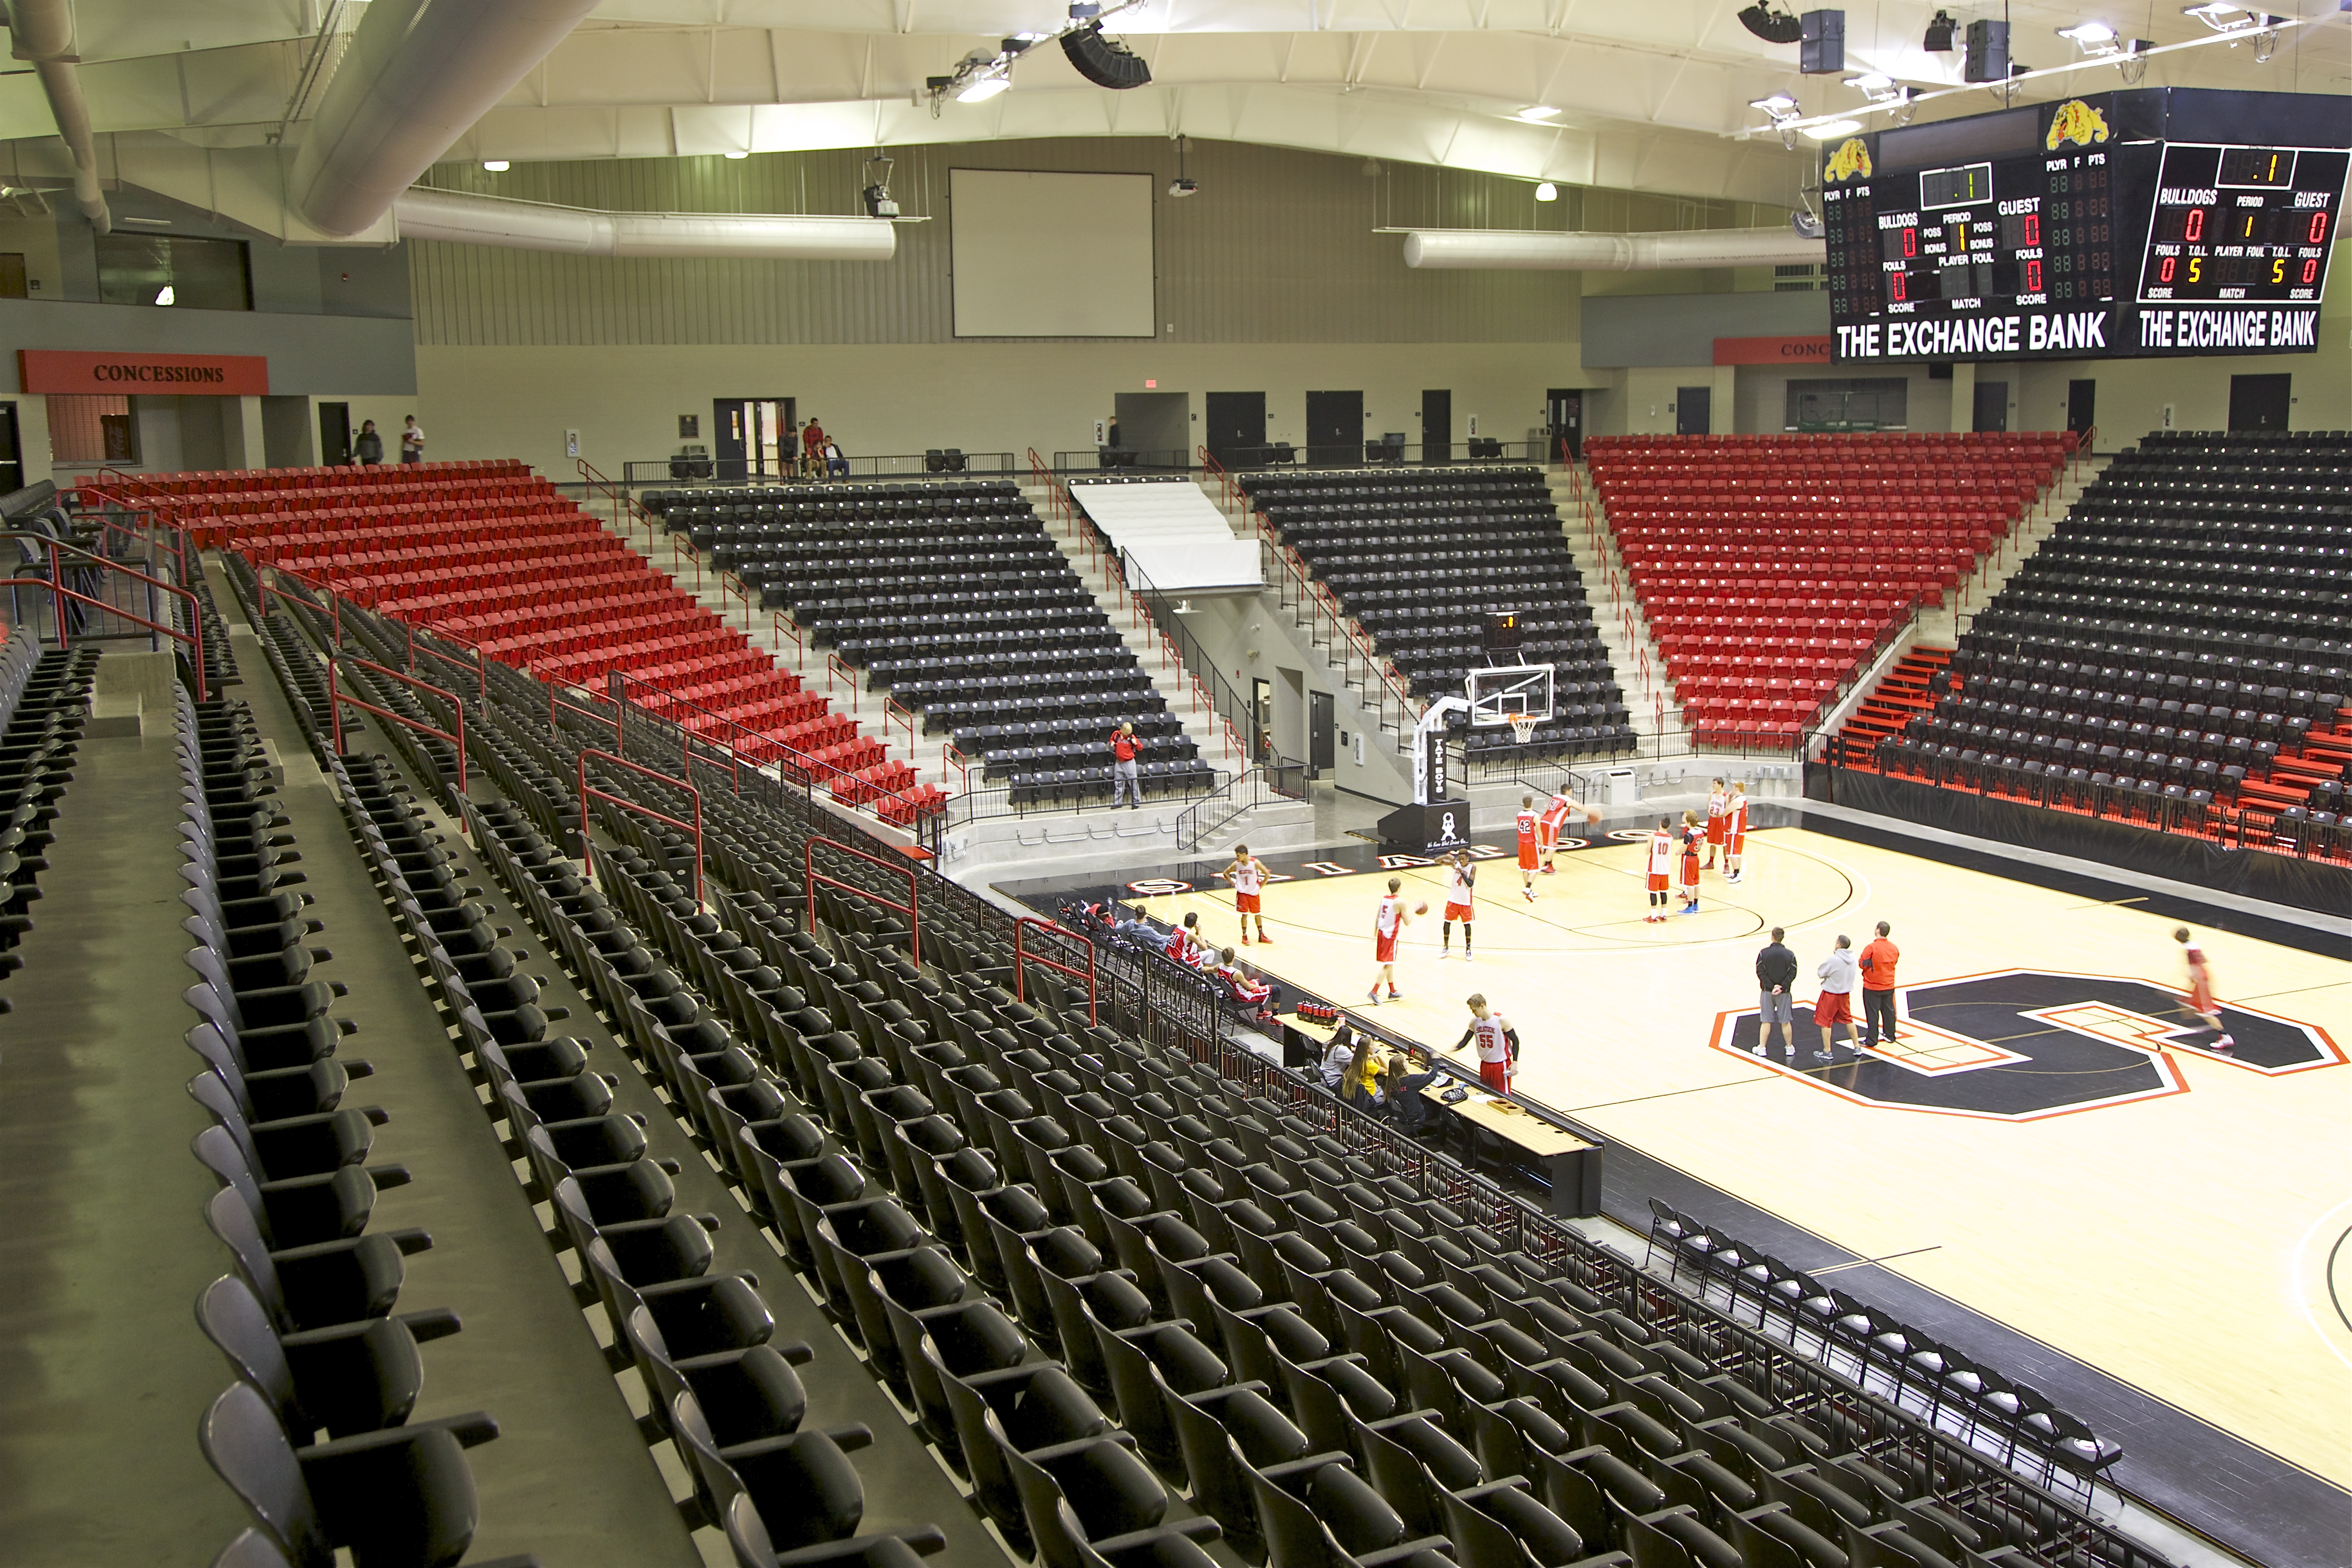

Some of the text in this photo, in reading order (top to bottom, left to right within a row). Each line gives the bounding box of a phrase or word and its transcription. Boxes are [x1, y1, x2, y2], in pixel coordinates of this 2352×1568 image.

[2046, 153, 2105, 171] PLYR F PTS
[1824, 186, 1870, 201] PLYR F PTS
[2160, 188, 2218, 205] BULLDOGS
[2295, 193, 2330, 207] GUEST
[1998, 197, 2040, 216] GUEST
[2237, 196, 2264, 207] PERIOD
[1879, 212, 1918, 230] BULLDOGS
[1943, 212, 1971, 224] PERIOD
[2186, 209, 2203, 241] 0
[1924, 227, 1942, 238] POSS
[1973, 221, 1993, 233] POSS
[2025, 215, 2039, 245] 0
[2245, 216, 2253, 237] 1
[2309, 213, 2327, 243] 0
[1903, 228, 1916, 257] 0
[1960, 224, 1965, 251] 1
[1970, 238, 1993, 249] BONUS
[1925, 243, 1947, 254] BONUS
[2016, 248, 2043, 260] FOULS
[2155, 245, 2180, 256] FOULS
[2189, 245, 2208, 256] T.O.L.
[2214, 246, 2265, 257] PLAYER FOUL
[2272, 247, 2291, 257] T.O.L.
[2298, 247, 2322, 258] FOULS
[1883, 260, 1906, 271] FOULS
[1939, 253, 1994, 267] PLAYER FOUL
[2027, 261, 2042, 291] 0
[2161, 258, 2175, 282] 0
[2189, 258, 2201, 282] 5
[2272, 259, 2284, 283] 5
[2303, 259, 2317, 283] 0
[1893, 272, 1906, 301] 0
[2148, 288, 2173, 298] SCORE
[2219, 288, 2245, 299] MATCH
[2016, 294, 2047, 305] SCORE
[2290, 289, 2313, 299] SCORE
[1888, 303, 1915, 314] SCORE
[1952, 298, 1980, 309] MATCH
[1837, 312, 2106, 358] THE EXCHANGE BANK
[2140, 311, 2316, 347] THE EXCHANGE BANK
[94, 364, 224, 383] CONCESSIONS
[1435, 739, 1443, 793] TATE BOYS
[1519, 820, 1531, 833] 42
[1658, 842, 1668, 855] 10
[1479, 1035, 1493, 1048] 55
